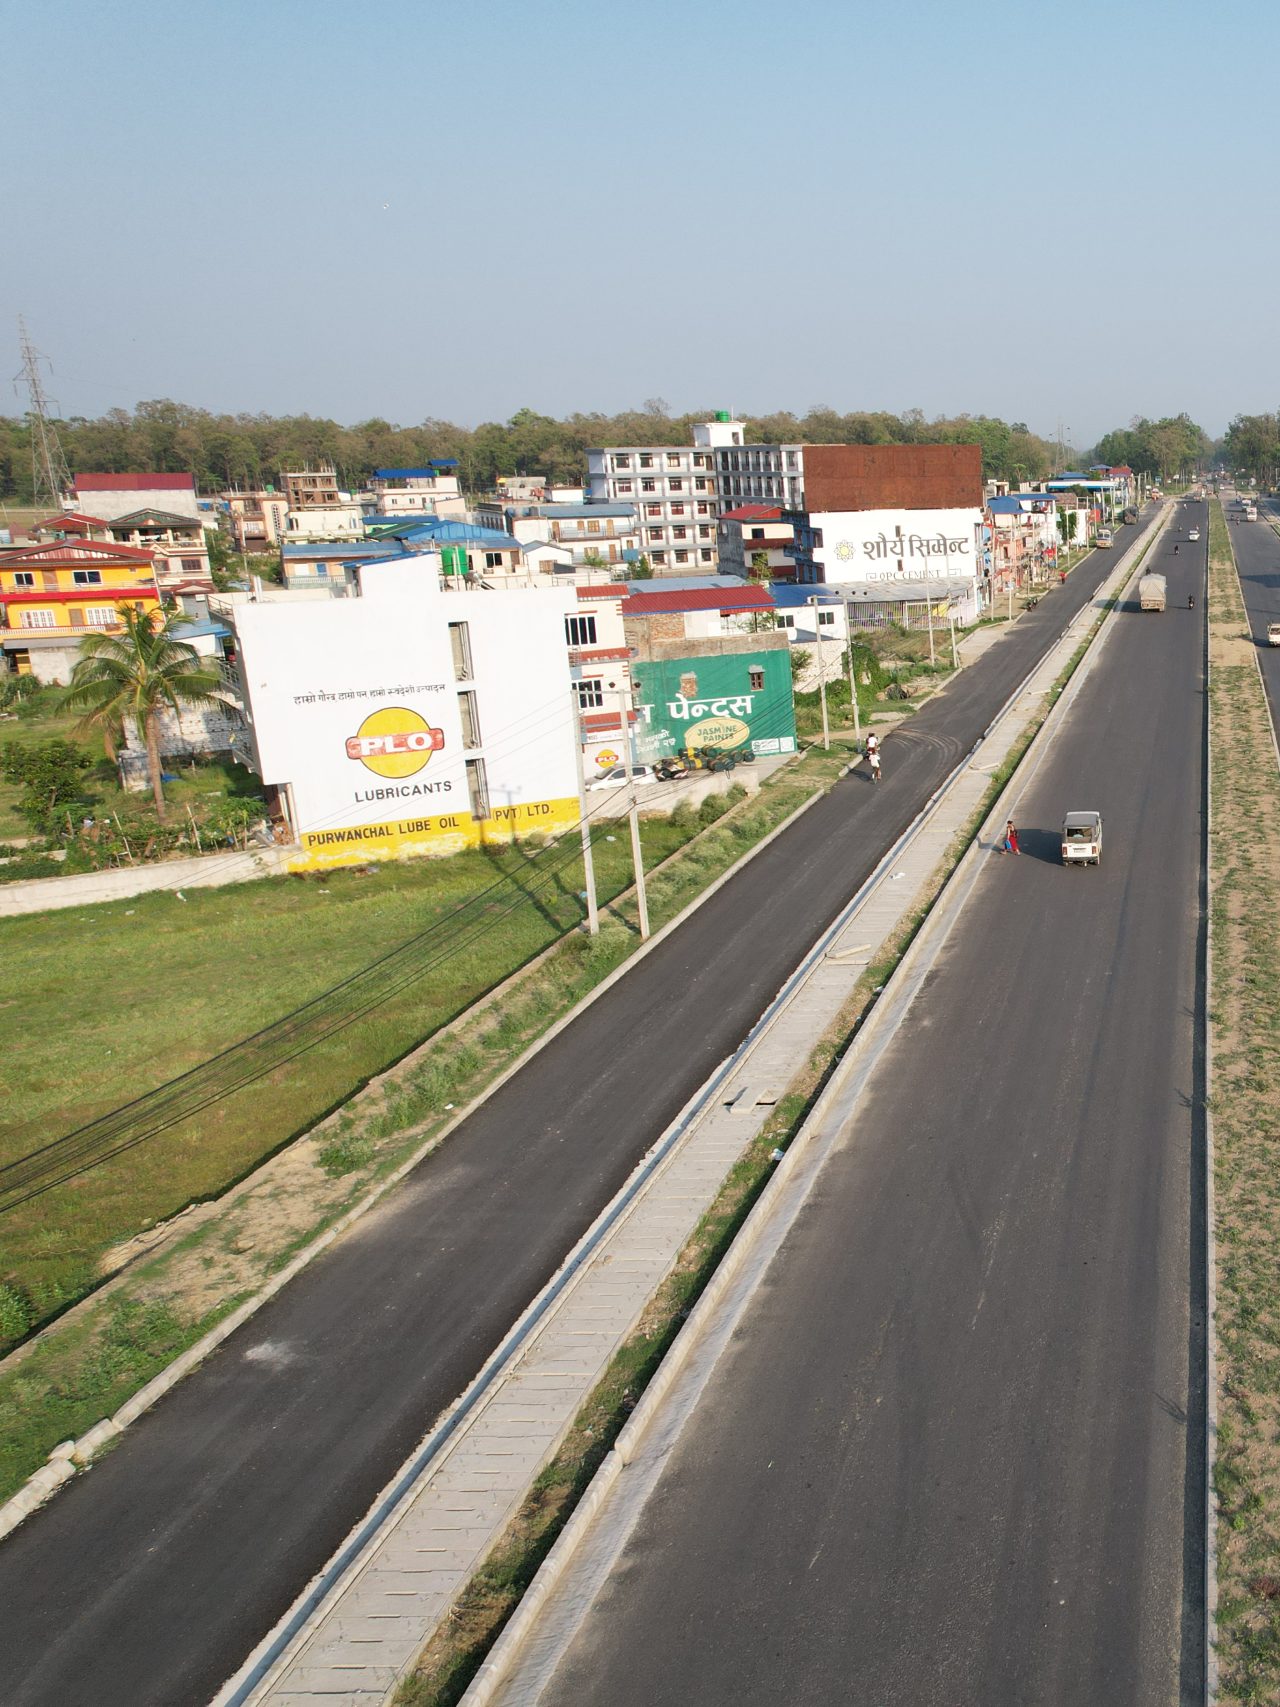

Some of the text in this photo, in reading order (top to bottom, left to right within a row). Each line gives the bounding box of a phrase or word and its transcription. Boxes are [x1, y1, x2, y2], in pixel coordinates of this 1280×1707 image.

[902, 569, 941, 580] CEMENT
[360, 732, 433, 756] PLO
[703, 733, 735, 743] PAINTS
[355, 780, 452, 803] LUBRICANTS
[308, 826, 393, 847] PURWANCHAL
[398, 819, 431, 835] LUBE
[439, 817, 460, 830] OIL
[527, 803, 555, 817] LTD.
